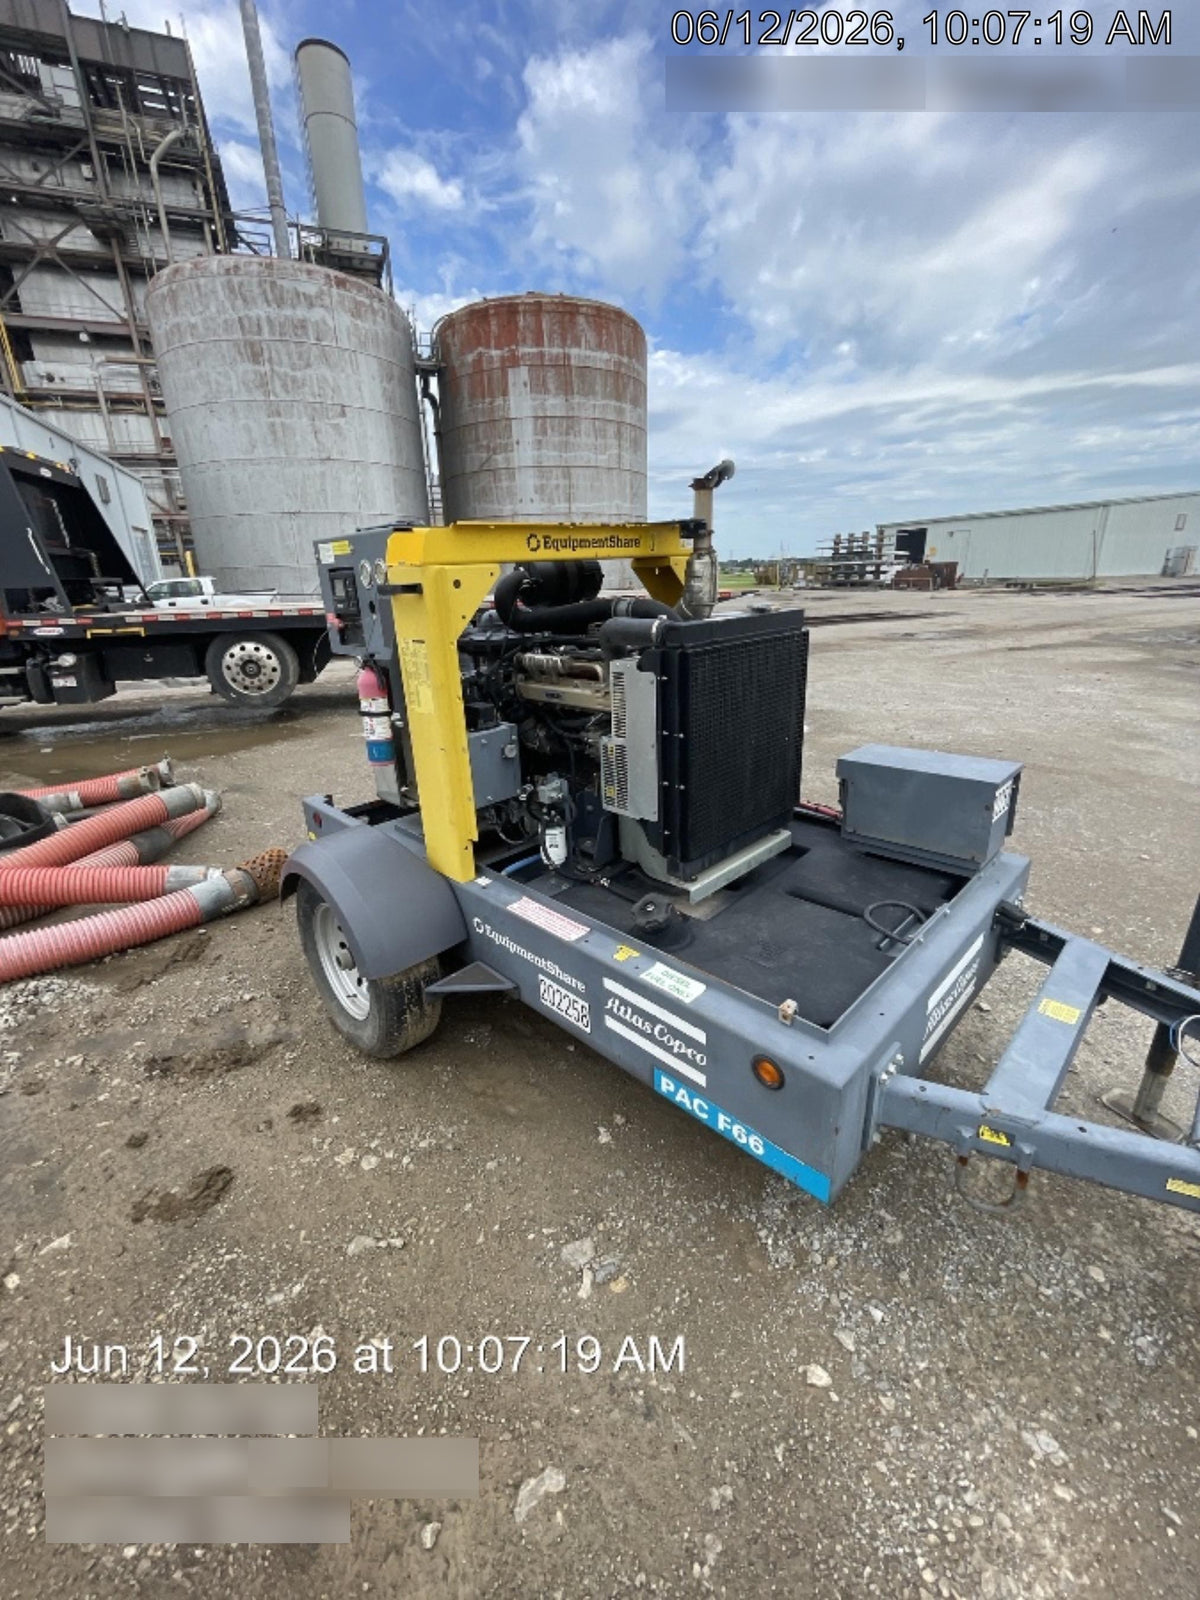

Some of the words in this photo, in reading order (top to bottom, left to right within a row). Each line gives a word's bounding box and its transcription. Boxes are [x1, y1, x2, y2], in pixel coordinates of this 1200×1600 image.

[542, 533, 642, 552] EquipmentShare
[485, 923, 586, 993] EquipmentShare
[540, 979, 591, 1029] 202258
[604, 997, 653, 1034] Atlas
[654, 1023, 707, 1066] Copco
[660, 1074, 709, 1119] PAC
[717, 1111, 765, 1156] F66
